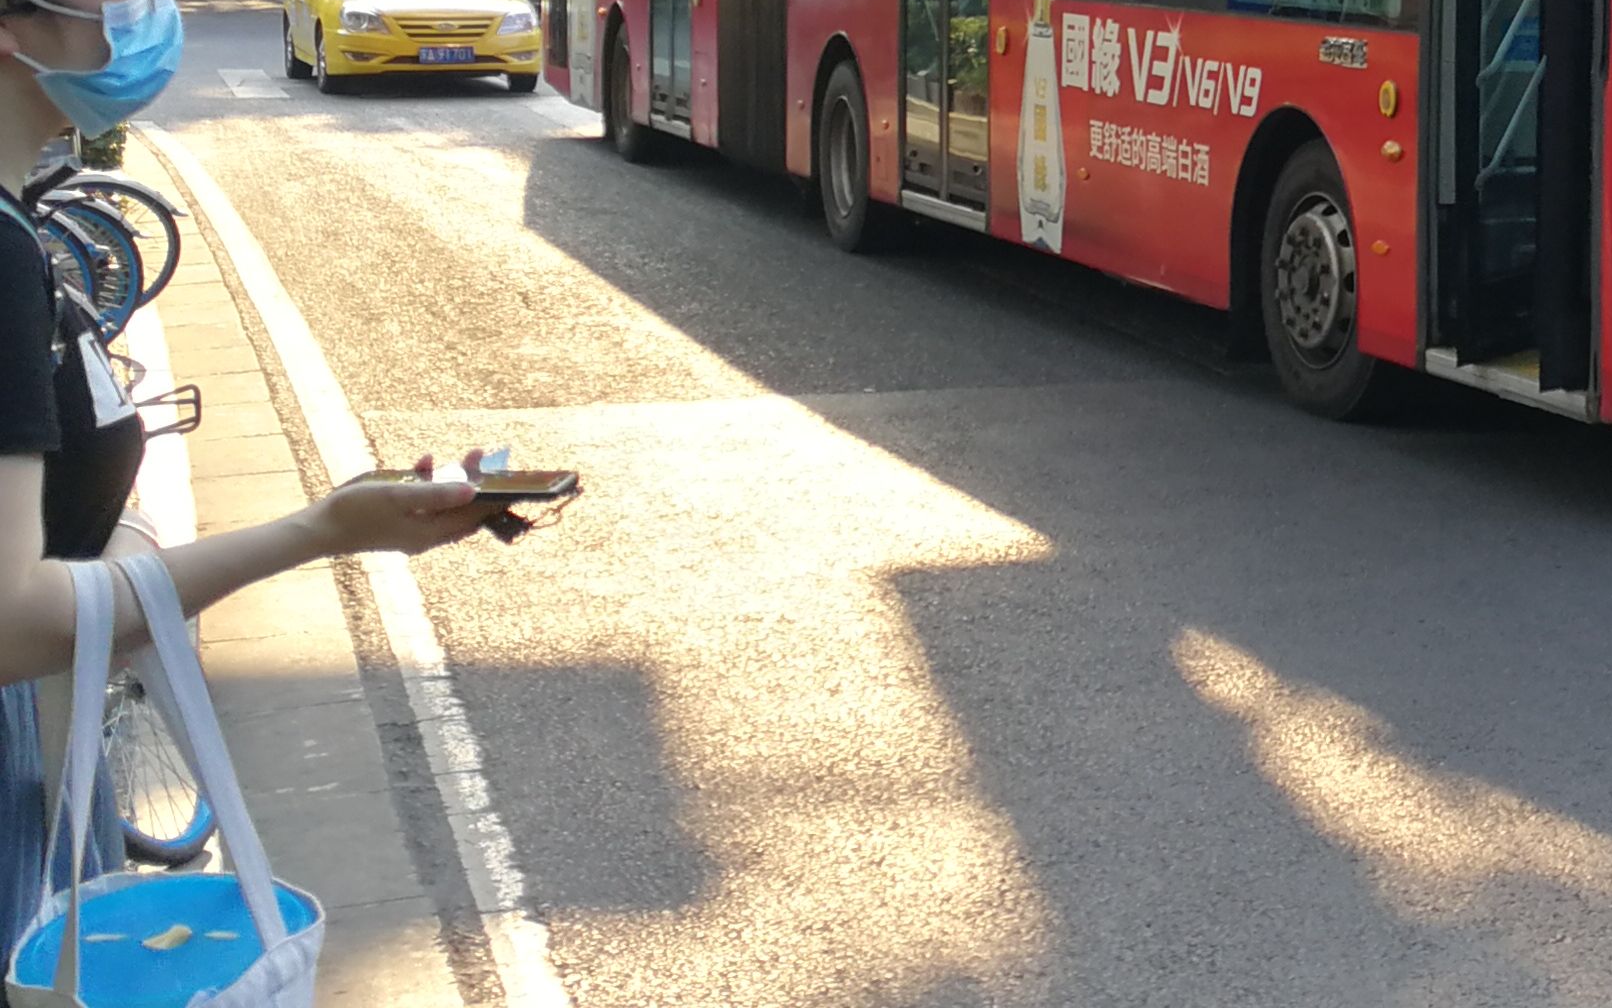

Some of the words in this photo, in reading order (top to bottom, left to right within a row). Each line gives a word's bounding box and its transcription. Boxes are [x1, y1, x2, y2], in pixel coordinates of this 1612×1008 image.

[1089, 119, 1210, 186] 更舒适的高端白酒
